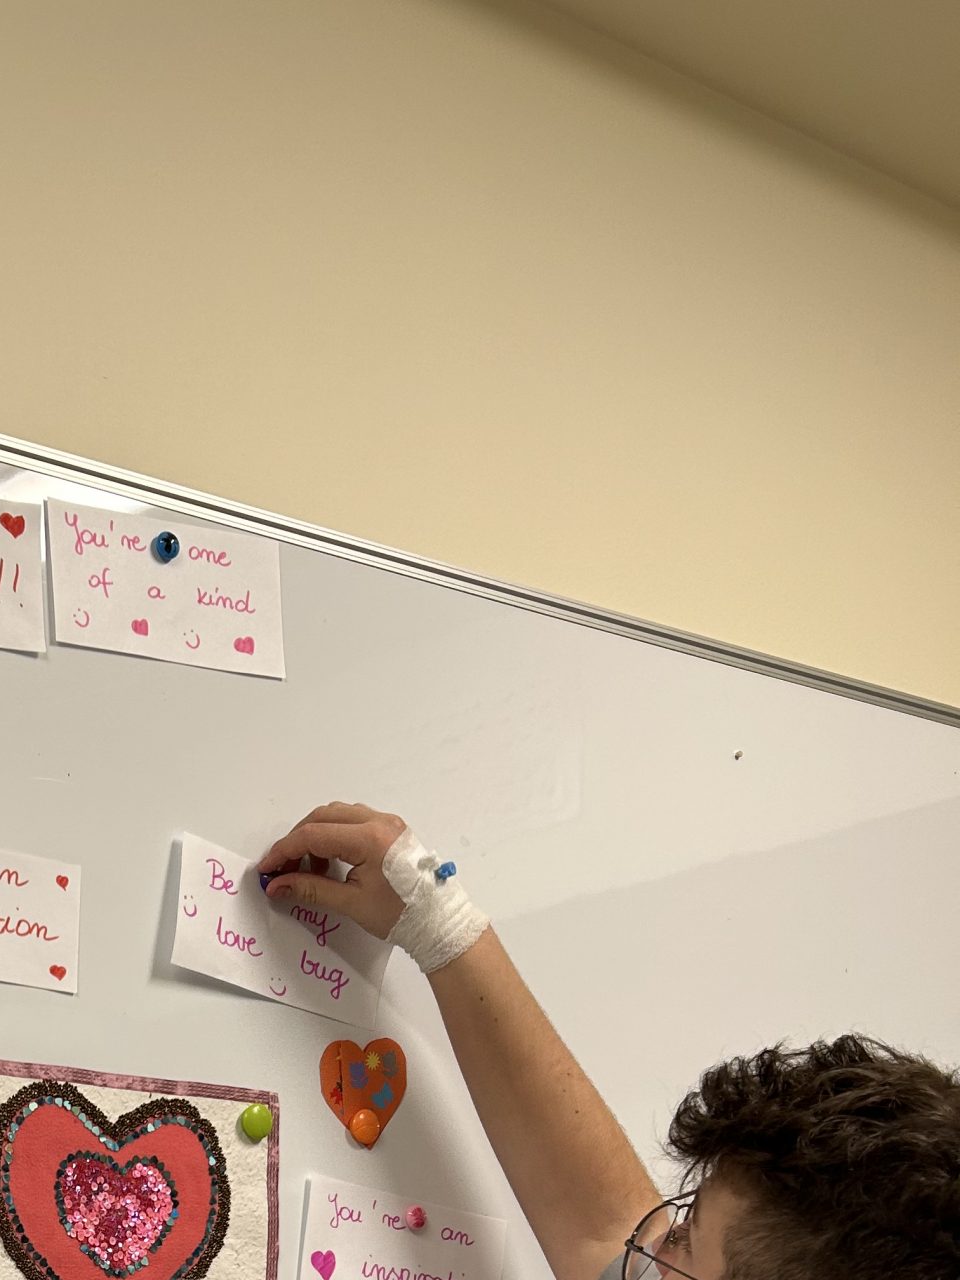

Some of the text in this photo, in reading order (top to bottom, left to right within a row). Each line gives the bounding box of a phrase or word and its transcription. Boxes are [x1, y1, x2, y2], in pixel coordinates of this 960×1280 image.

[64, 512, 232, 567] You're one
[88, 573, 256, 614] of a kind
[206, 858, 339, 946] Be my
[216, 916, 350, 999] love bug
[441, 1227, 474, 1246] an
